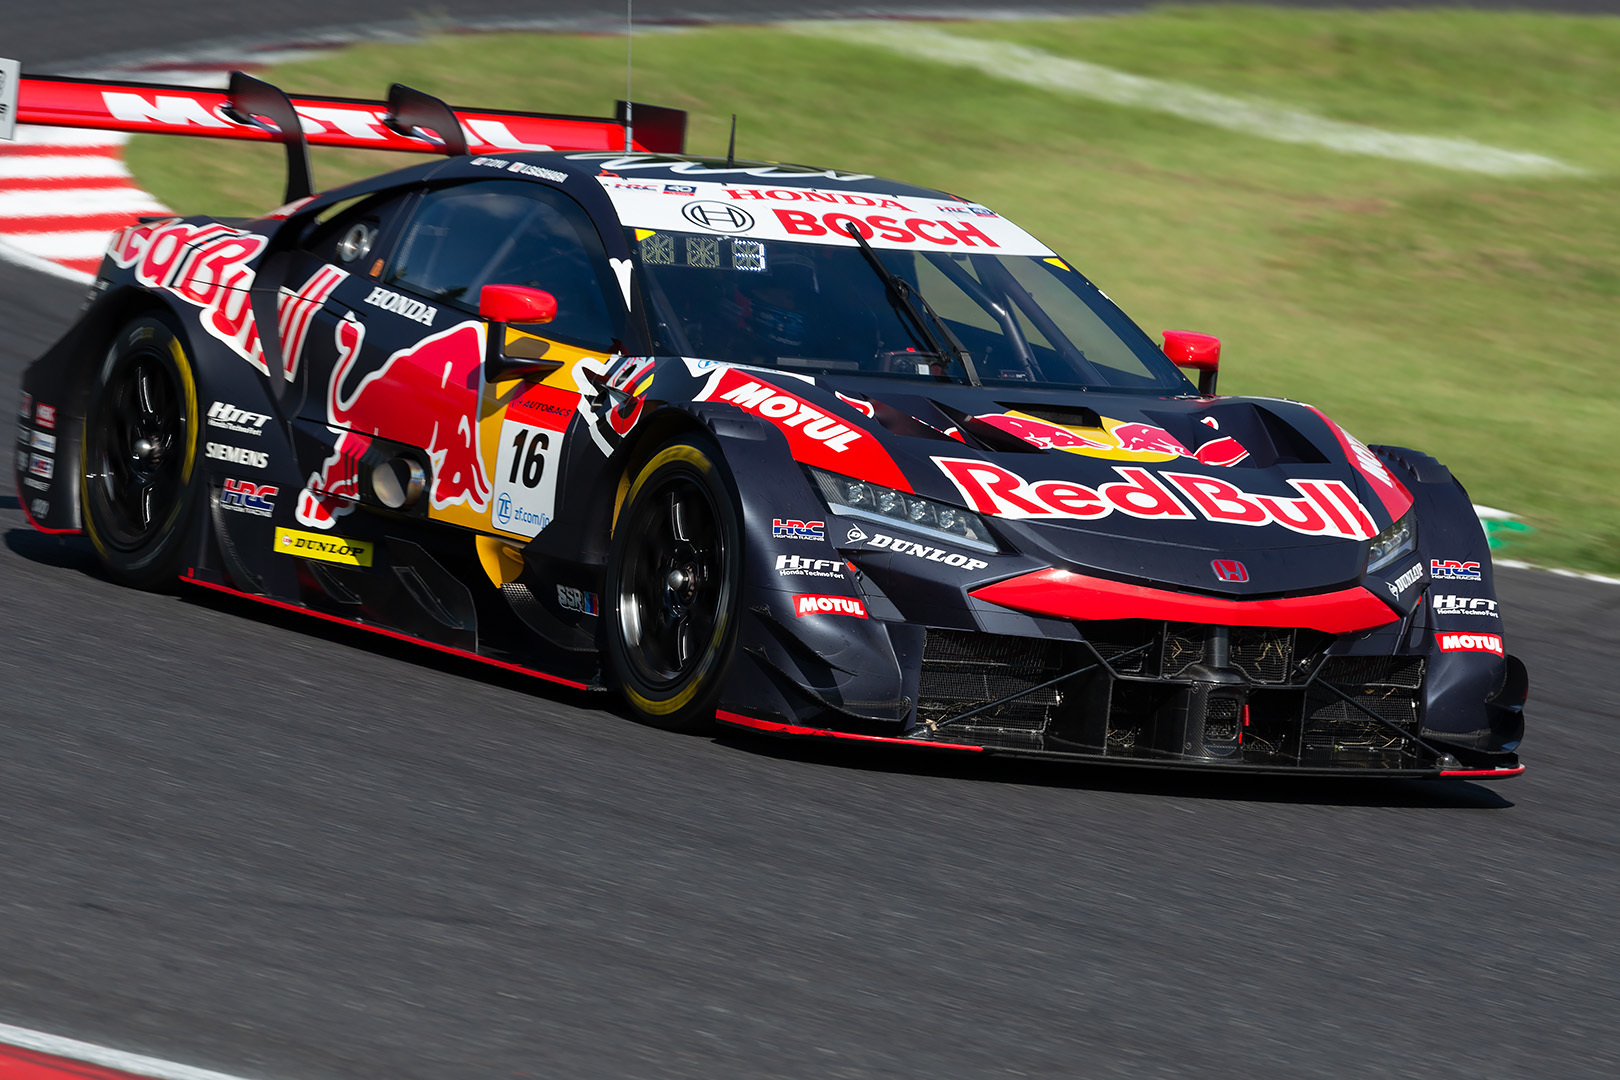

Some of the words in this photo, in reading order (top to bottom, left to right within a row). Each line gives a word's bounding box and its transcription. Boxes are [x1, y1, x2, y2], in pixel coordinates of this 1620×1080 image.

[722, 189, 917, 212] HONDA
[772, 208, 1001, 248] BOSCH
[363, 286, 438, 327] HONDA
[207, 401, 272, 427] HTFT
[523, 402, 571, 417] AUTOBACS
[719, 382, 862, 453] MOTUL
[205, 442, 269, 469] SIEMENS
[508, 428, 549, 489] 16
[221, 478, 279, 512] HRC
[773, 519, 824, 537] HRC
[294, 538, 364, 557] DUNLOP
[867, 533, 988, 571] DUNLOP
[775, 555, 844, 572] HTFT
[1431, 559, 1481, 576] HRC
[1394, 562, 1424, 593] DUNLOP
[556, 584, 583, 610] SSR
[799, 597, 864, 615] MOTUL
[1433, 595, 1497, 611] HTFT
[1442, 635, 1502, 653] MOTUL
